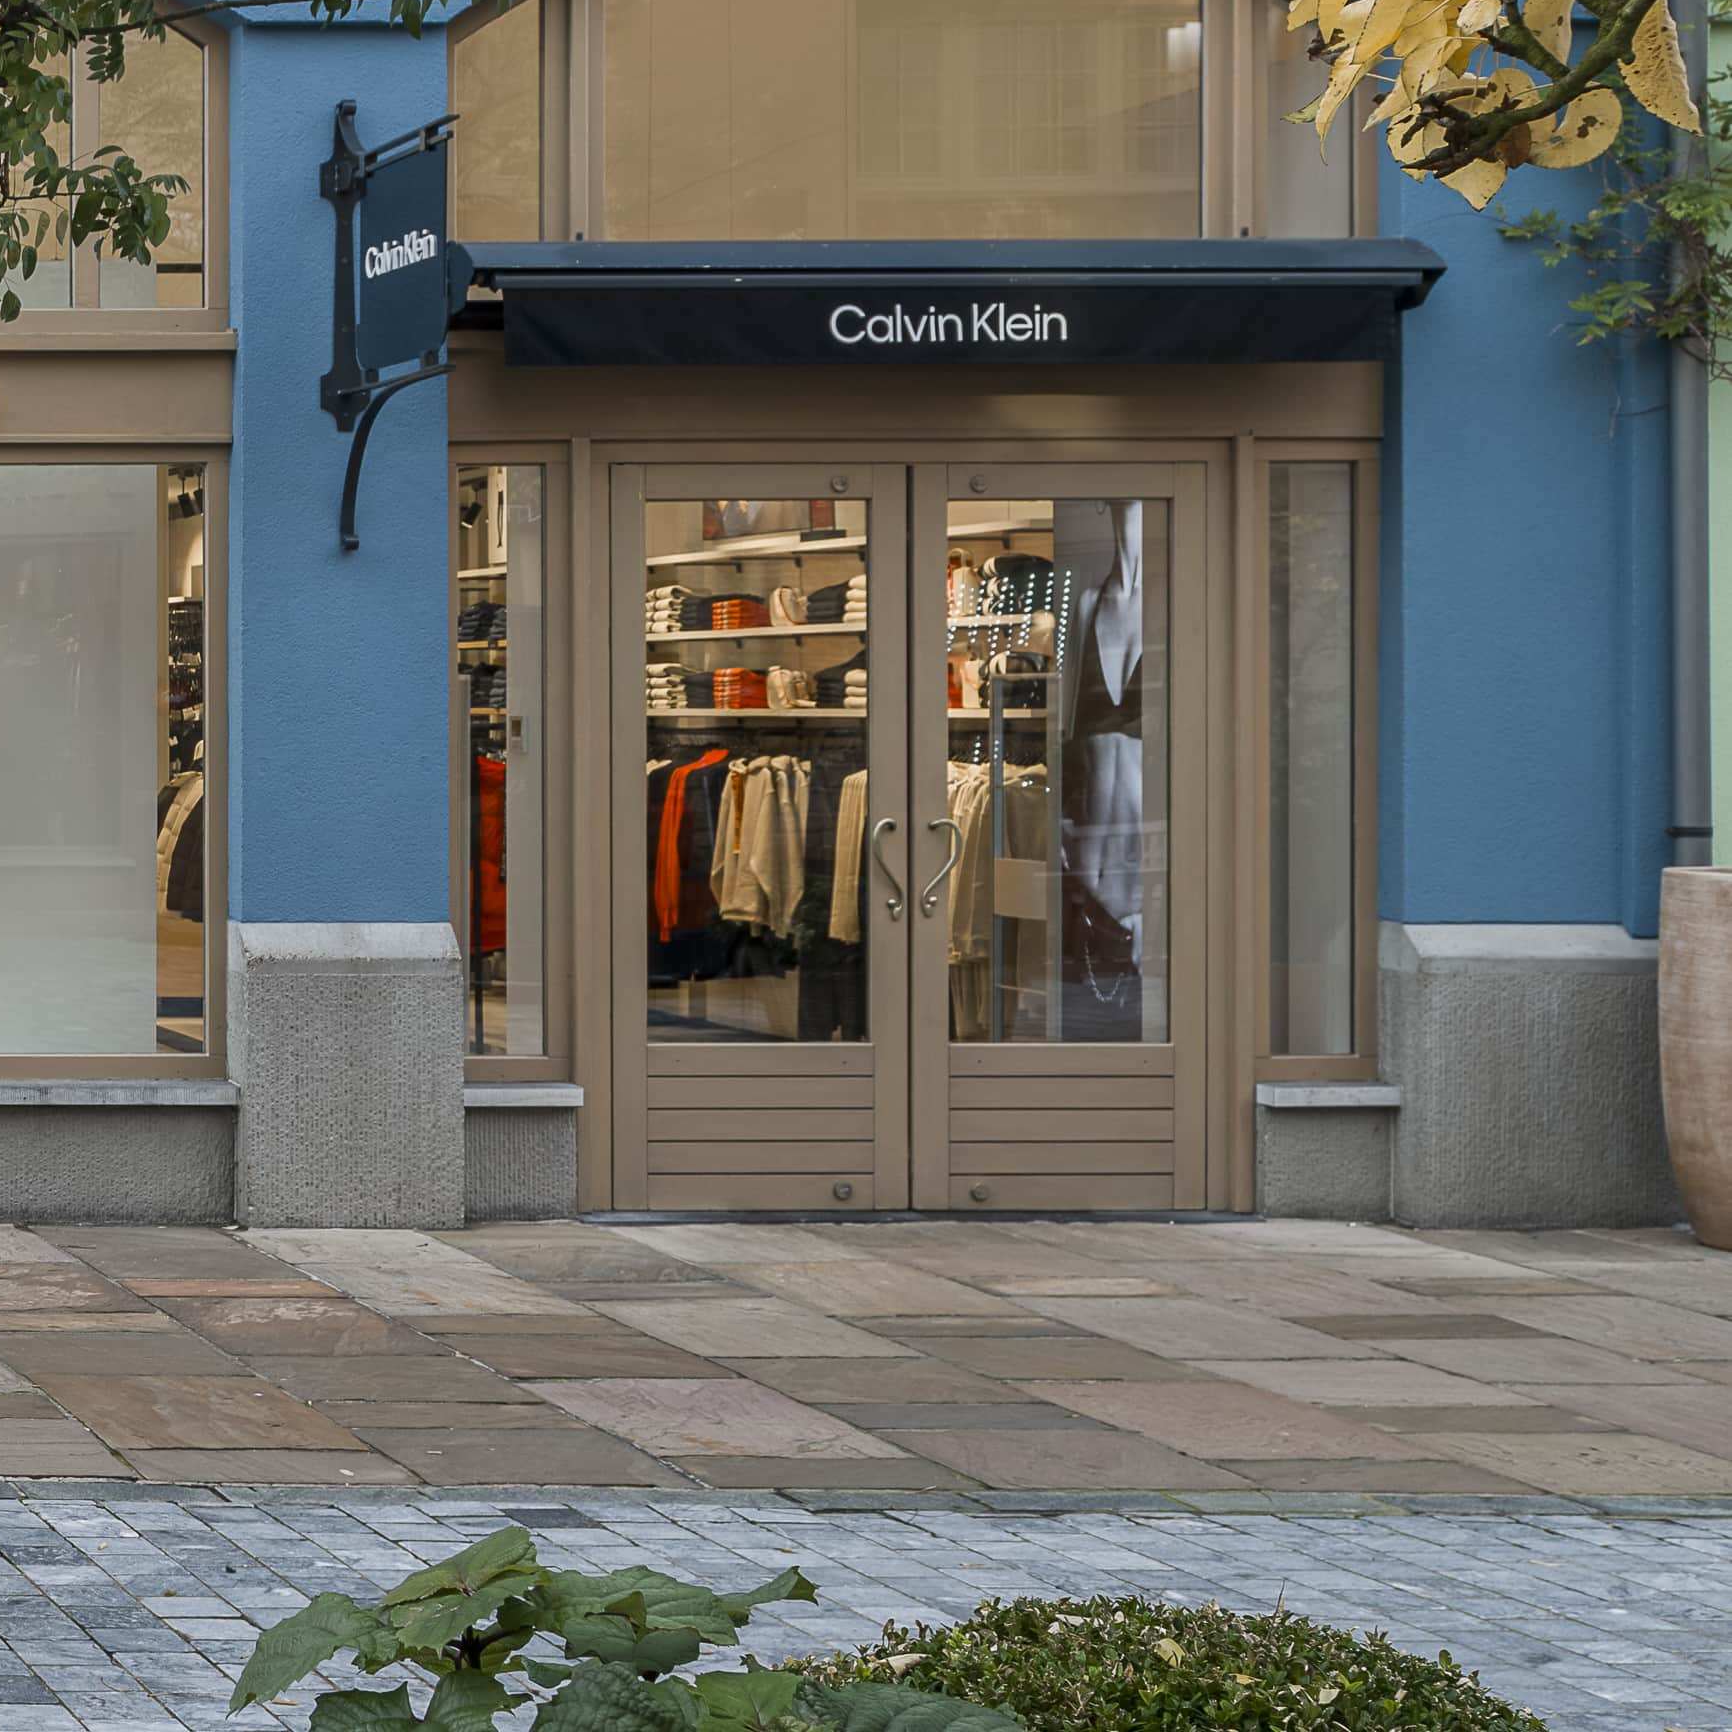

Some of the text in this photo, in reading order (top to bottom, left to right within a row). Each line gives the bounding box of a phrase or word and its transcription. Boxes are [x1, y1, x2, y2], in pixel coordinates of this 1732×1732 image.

[365, 229, 438, 279] Calvin Klein
[829, 302, 1068, 344] Calvin Klein
